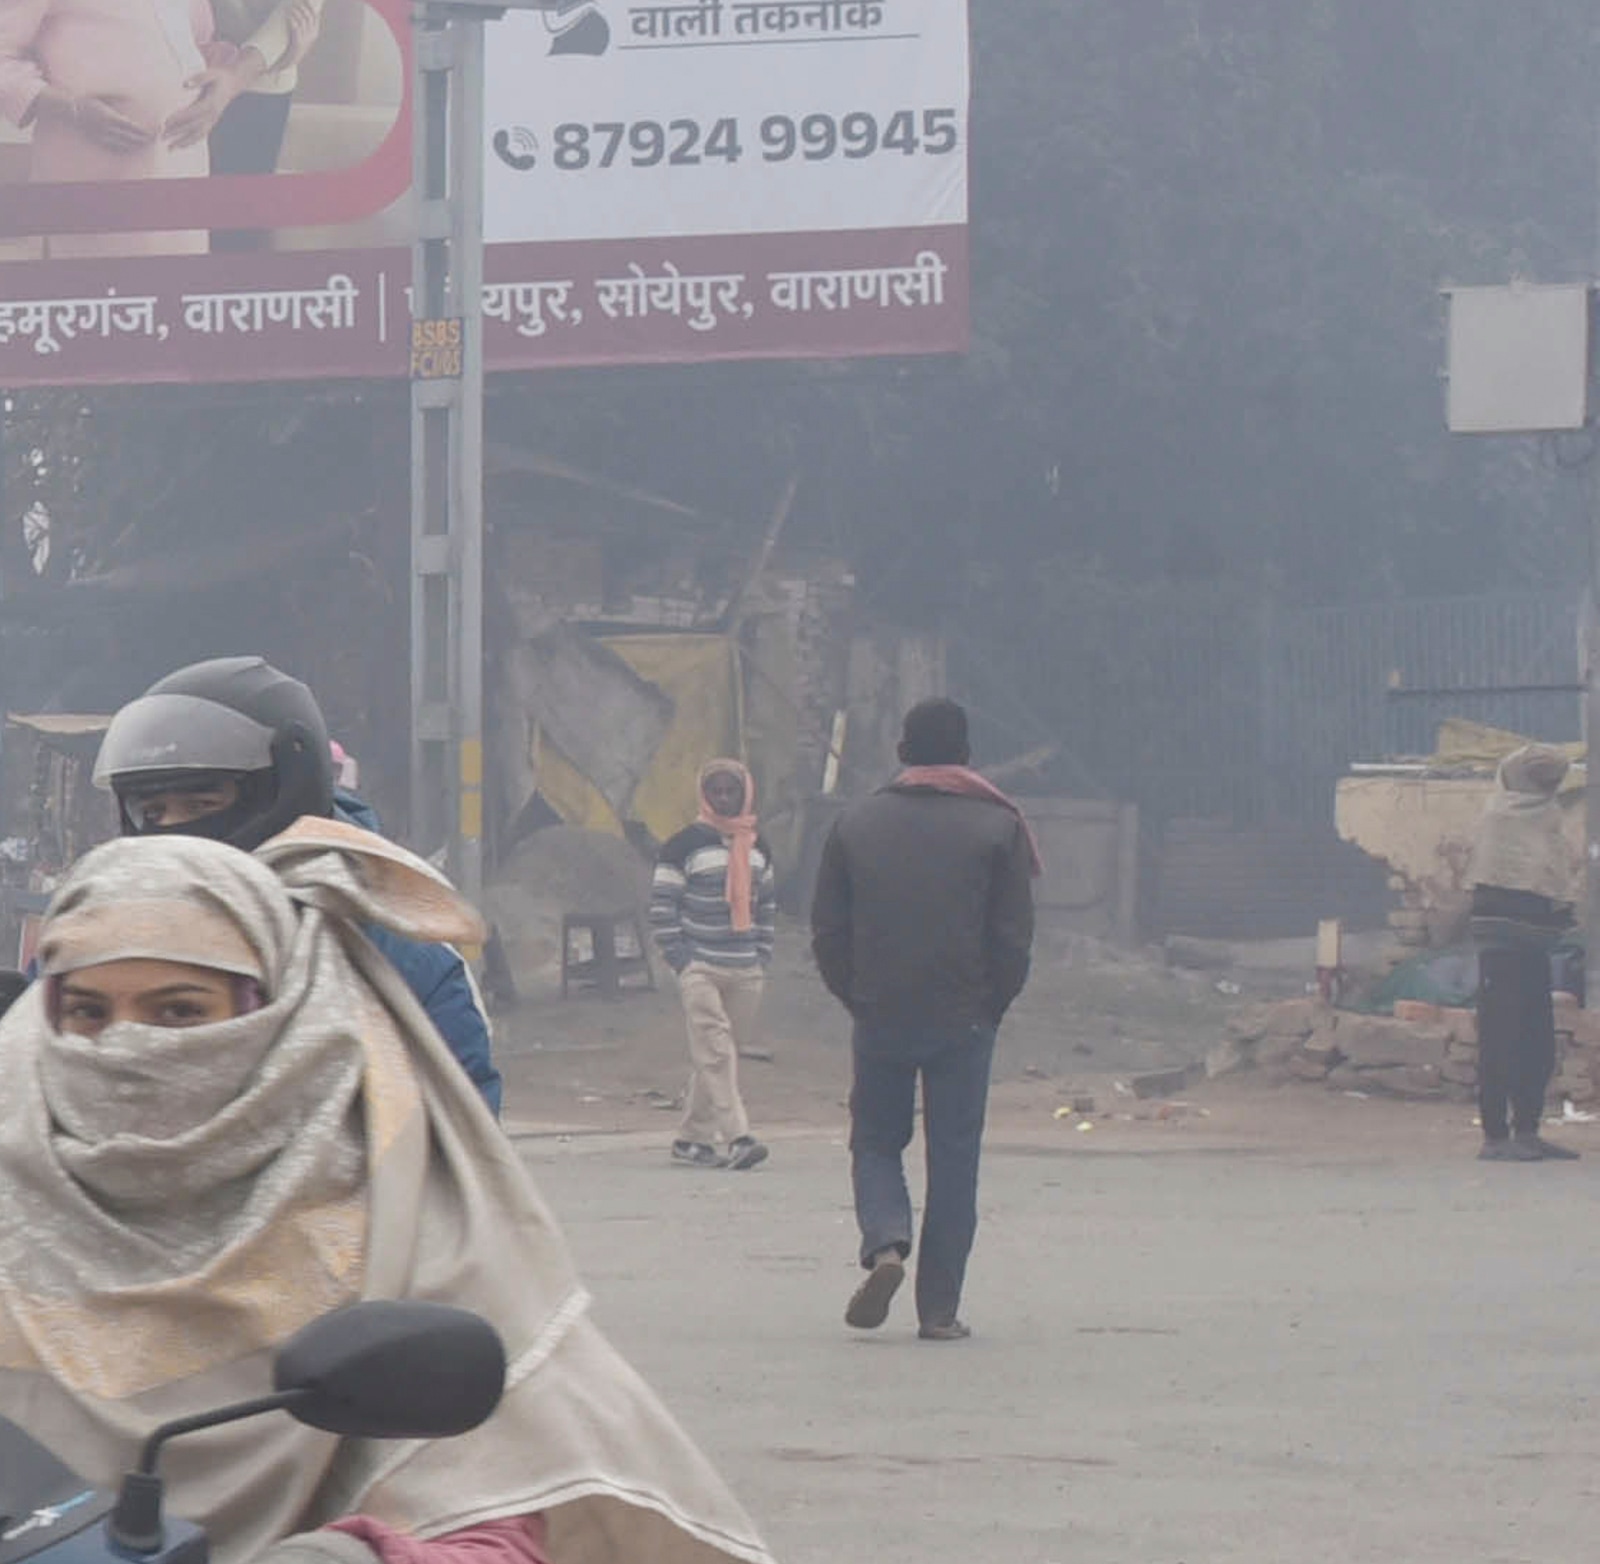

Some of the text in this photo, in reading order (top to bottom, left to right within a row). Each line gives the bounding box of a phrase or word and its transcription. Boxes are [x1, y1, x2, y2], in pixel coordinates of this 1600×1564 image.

[552, 108, 958, 171] 87924 99945
[181, 273, 359, 335] वाराणसी
[594, 261, 755, 330] सोयेपुर,
[767, 251, 948, 311] वाराणसी
